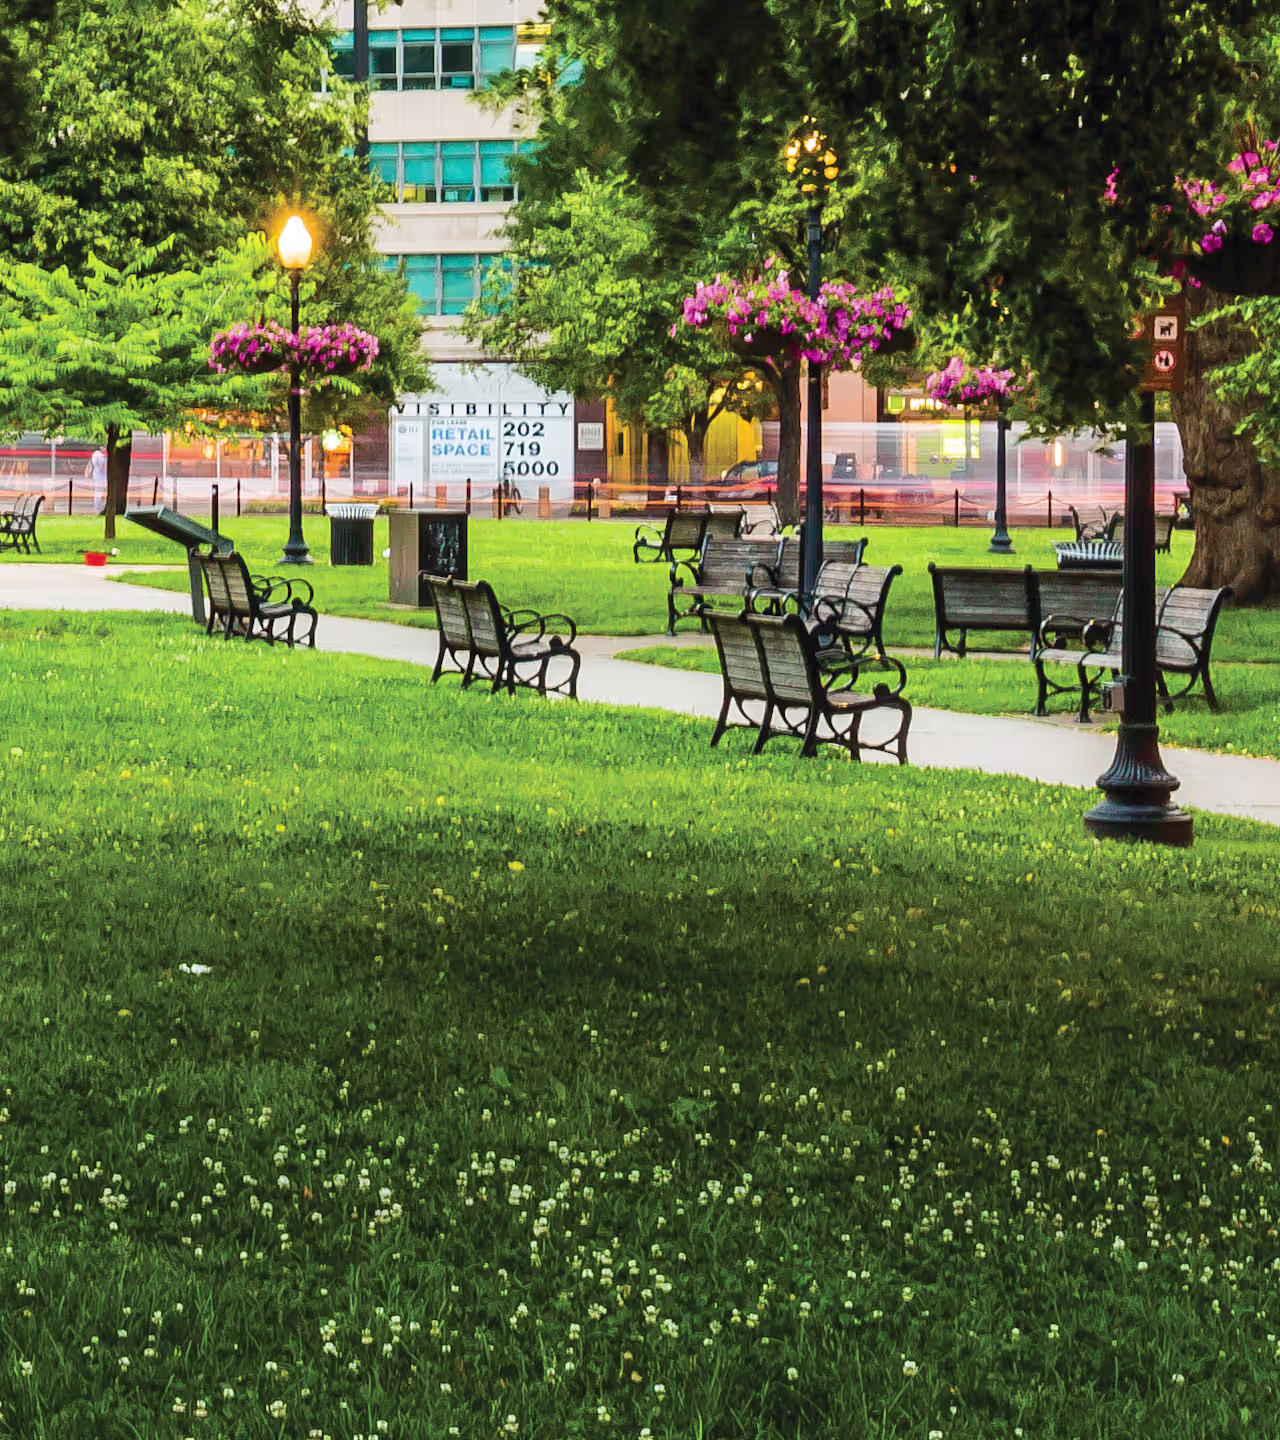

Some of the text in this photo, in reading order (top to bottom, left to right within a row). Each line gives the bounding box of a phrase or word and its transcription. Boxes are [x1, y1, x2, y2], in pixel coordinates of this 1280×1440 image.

[396, 402, 569, 416] VISIBILITY
[432, 428, 495, 440] RETAIL
[503, 421, 545, 437] 202
[432, 443, 491, 456] SPACE
[503, 441, 541, 456] 719
[503, 461, 559, 476] 5000
